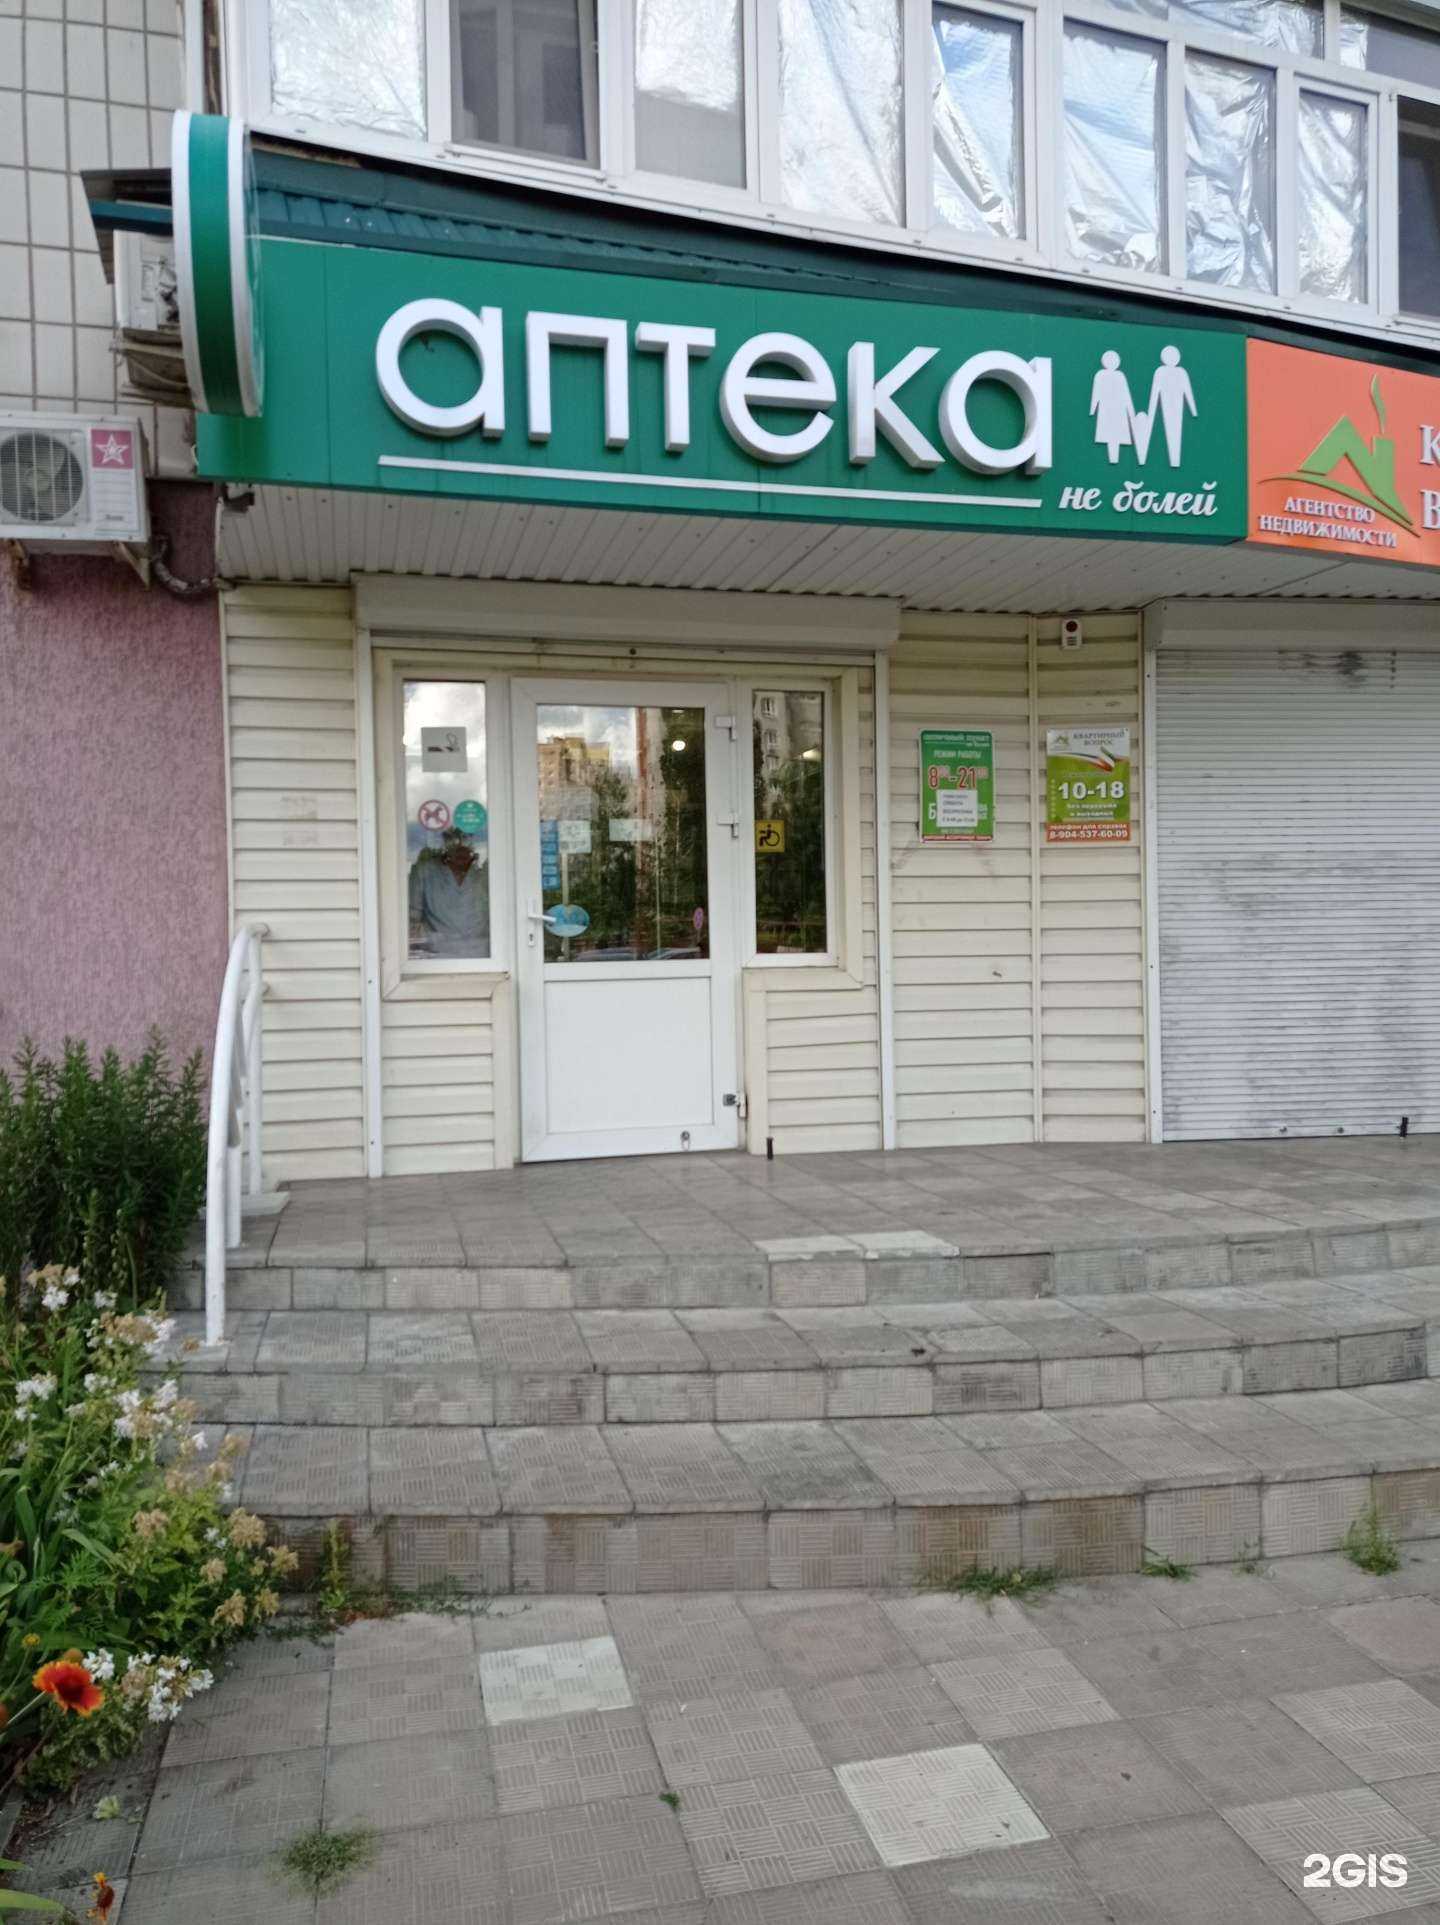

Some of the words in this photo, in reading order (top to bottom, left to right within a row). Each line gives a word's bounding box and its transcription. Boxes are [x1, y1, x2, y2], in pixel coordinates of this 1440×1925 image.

[375, 298, 1053, 477] аптека
[1058, 486, 1103, 511] не
[1112, 480, 1219, 517] болей
[1283, 496, 1376, 524] АГЕНТСТВО
[1259, 514, 1398, 549] НЕДВИЖИМОСТИ
[1058, 781, 1125, 800] 10-18
